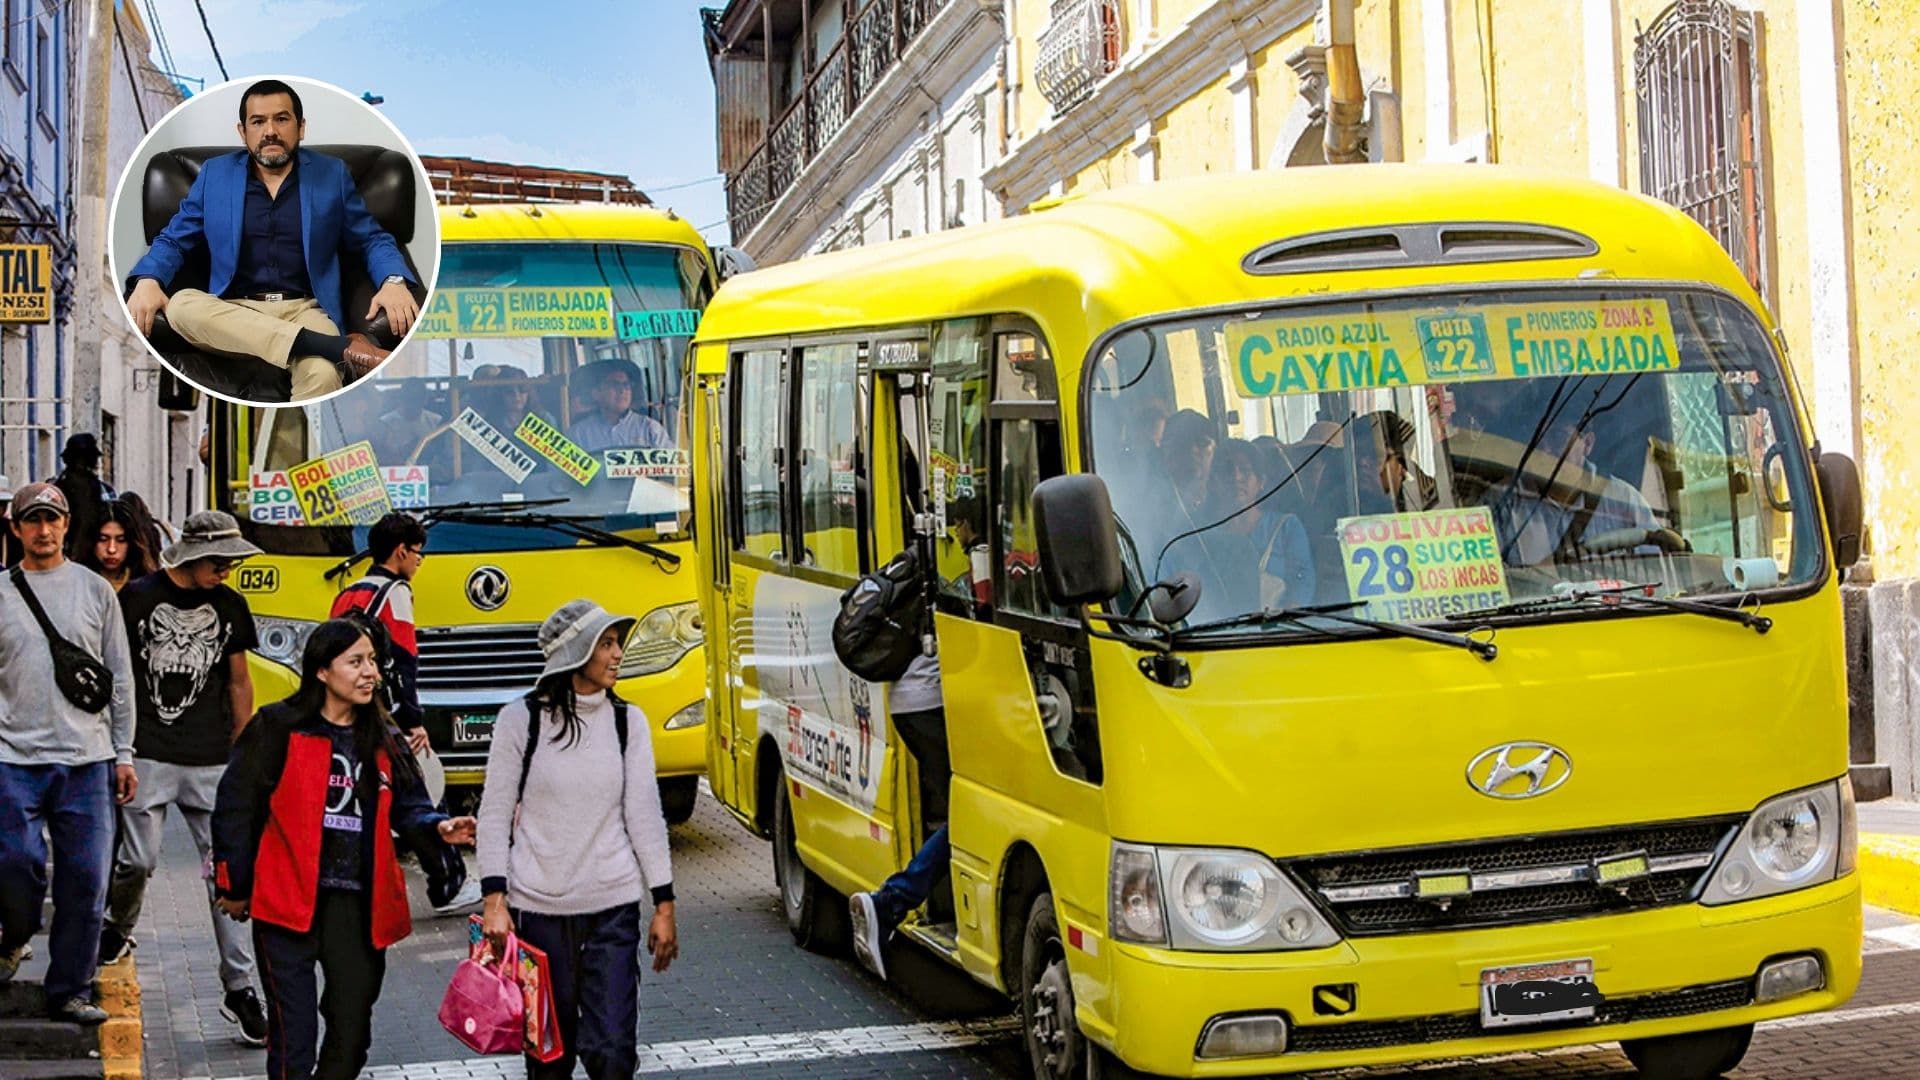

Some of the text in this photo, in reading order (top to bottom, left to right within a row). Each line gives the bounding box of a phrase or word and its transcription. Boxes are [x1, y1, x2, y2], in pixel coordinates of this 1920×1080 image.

[0, 296, 44, 308] NESI
[465, 293, 499, 304] RUTA
[509, 291, 608, 313] EMBAJADA
[416, 318, 451, 333] ZUL
[469, 304, 497, 331] 22
[512, 316, 608, 331] PIONEROS ZONA B
[1429, 318, 1473, 338] RUTA
[1526, 310, 1598, 333] PIONEROS
[1601, 305, 1642, 328] ZONA
[1275, 321, 1391, 349] RADIO AZUL
[1506, 316, 1671, 378] EMBAJADA
[1239, 334, 1409, 396] CAYMA
[1436, 338, 1481, 373] 22
[460, 409, 532, 473] AVELINO
[295, 448, 369, 488] BOLIVAR
[606, 449, 688, 466] SAGA
[253, 473, 288, 488] LA
[328, 464, 375, 491] SUCRE
[304, 484, 335, 519] 28
[1345, 512, 1489, 545] BOLIVAR
[1415, 538, 1495, 565] SUCRE
[241, 569, 275, 590] 034
[1352, 544, 1414, 597] 28
[1418, 564, 1500, 591] LOS INCAS
[1383, 590, 1504, 621] TERRESTRE
